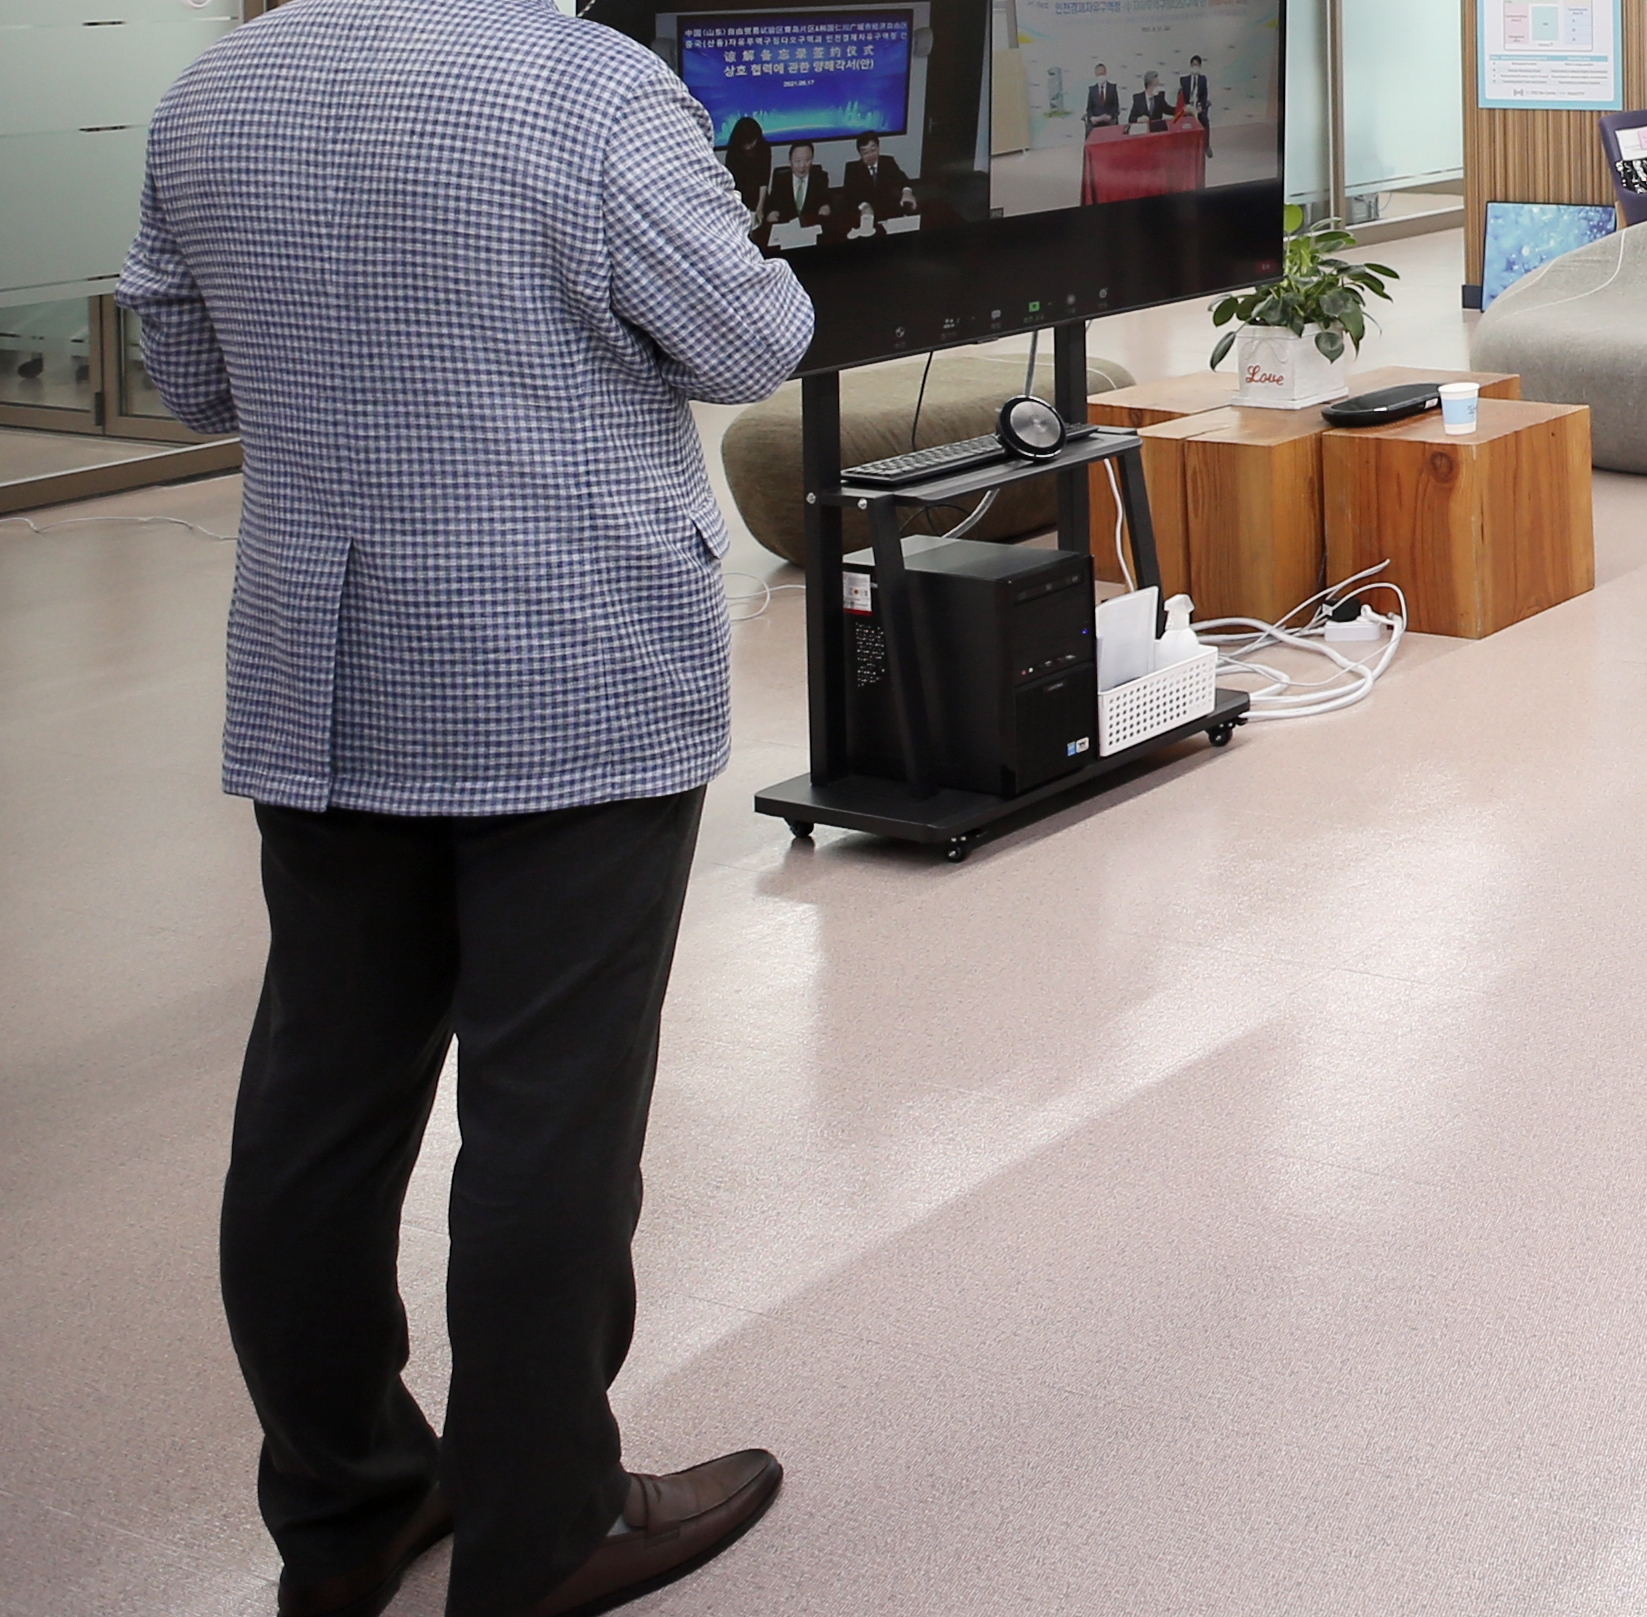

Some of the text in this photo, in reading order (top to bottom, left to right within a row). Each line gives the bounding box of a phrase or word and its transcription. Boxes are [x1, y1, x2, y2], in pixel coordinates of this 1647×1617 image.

[723, 65, 747, 77] 상호
[750, 63, 784, 76] 협력에
[787, 61, 810, 74] 관한
[1245, 364, 1285, 385] Love
